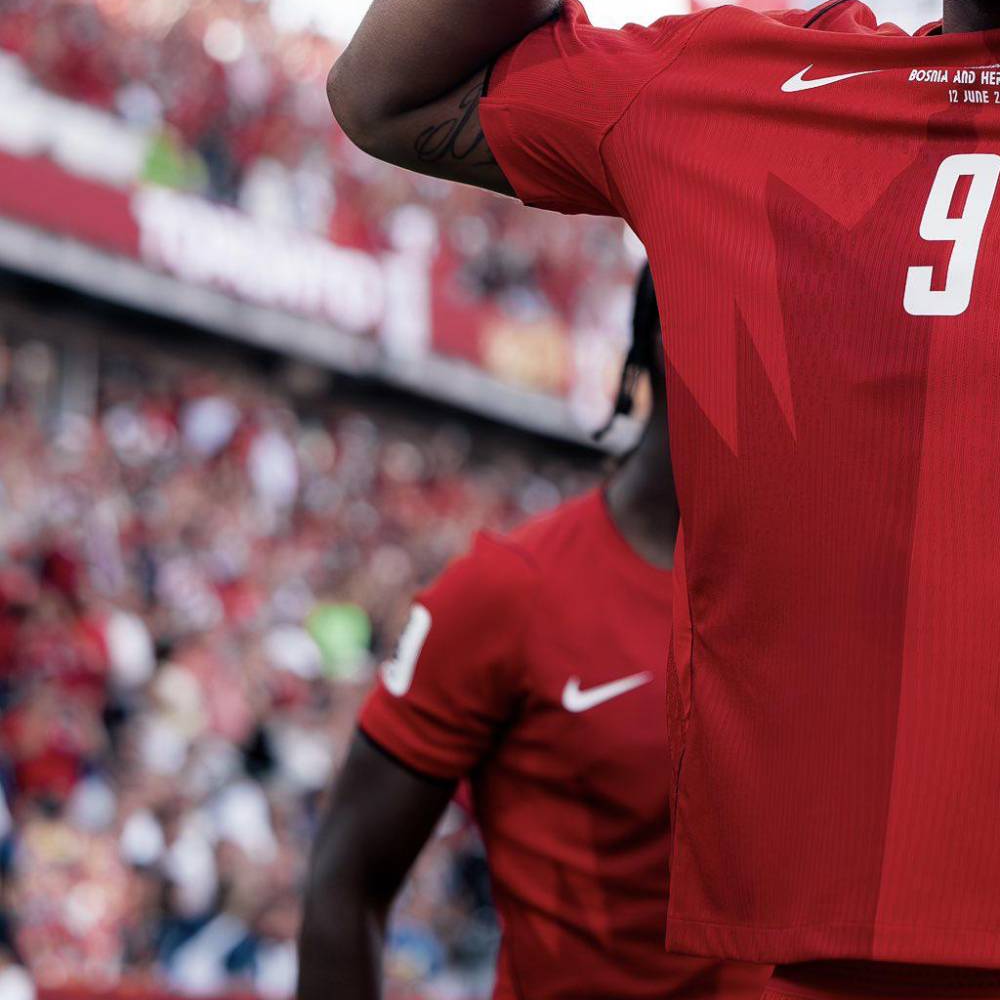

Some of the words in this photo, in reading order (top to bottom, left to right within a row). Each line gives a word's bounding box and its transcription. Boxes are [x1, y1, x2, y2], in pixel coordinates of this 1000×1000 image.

[908, 68, 949, 83] BOSNIA
[952, 69, 976, 84] AND
[948, 89, 959, 104] 12
[963, 90, 990, 104] JUNE
